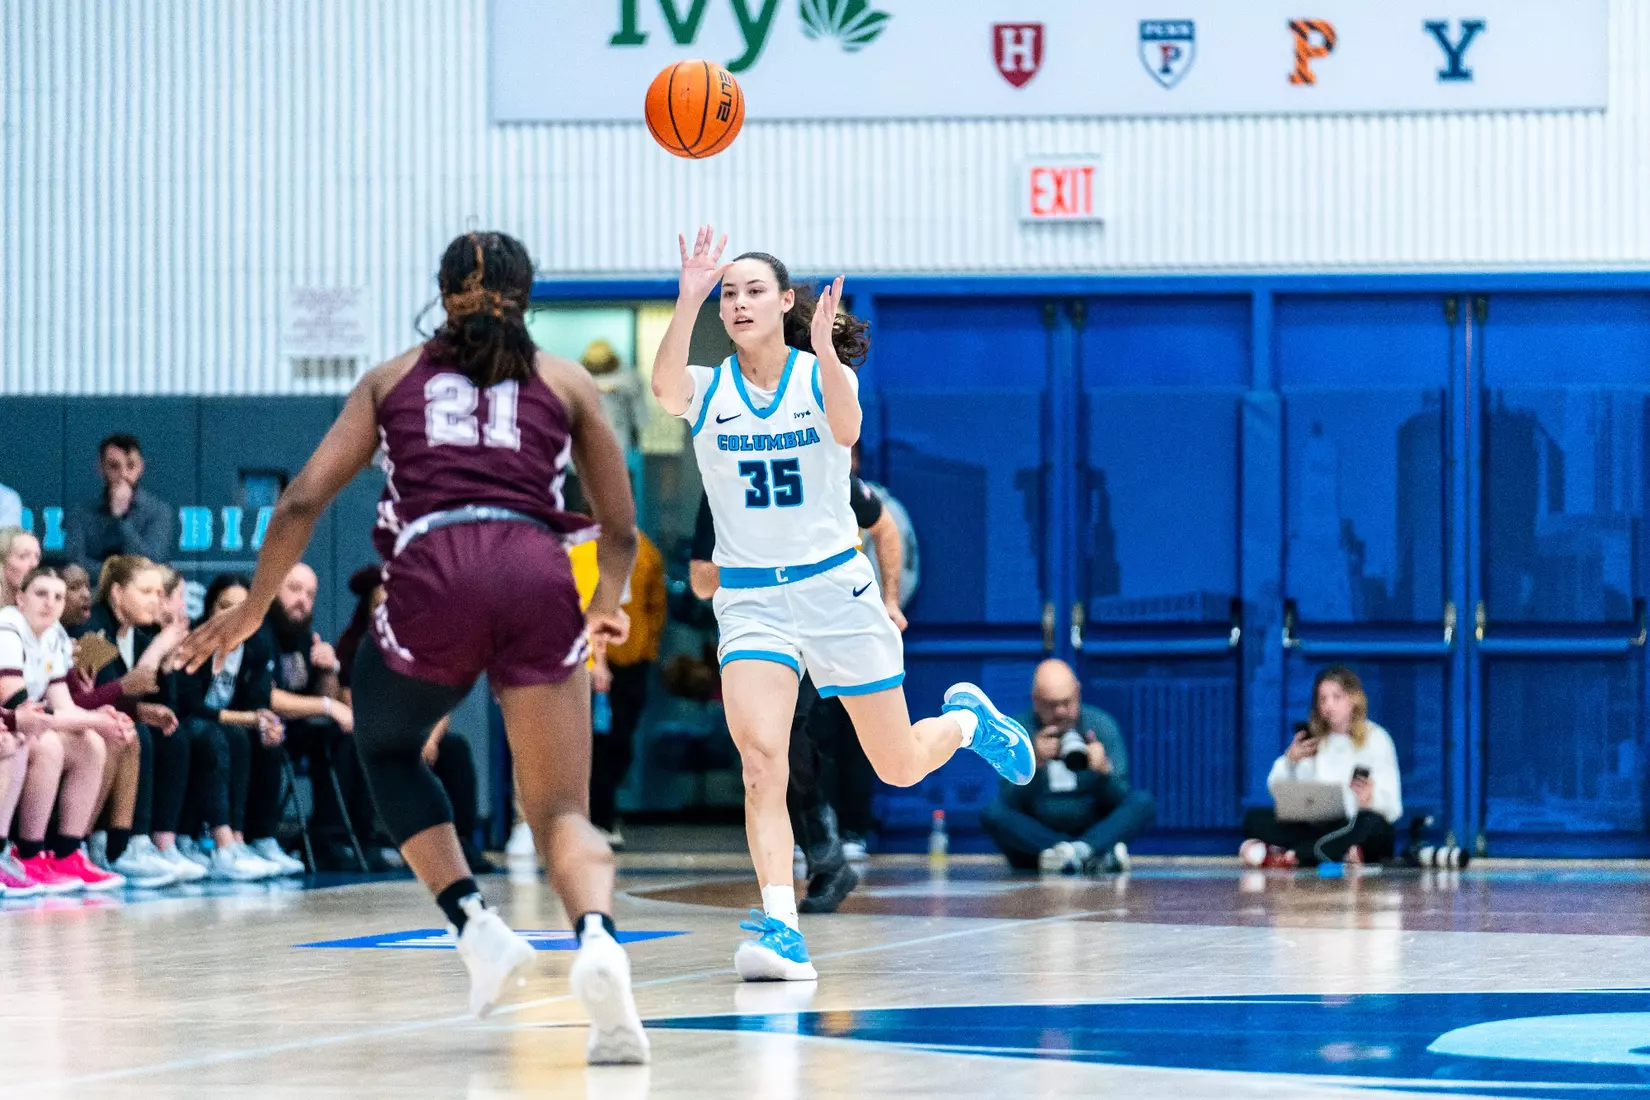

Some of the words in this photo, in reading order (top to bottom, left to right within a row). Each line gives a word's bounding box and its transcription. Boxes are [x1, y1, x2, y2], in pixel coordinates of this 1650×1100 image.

[1001, 27, 1035, 71] H
[1160, 44, 1181, 74] P
[1288, 18, 1337, 85] P
[1423, 19, 1486, 82] Y
[716, 71, 732, 122] ELITE
[1030, 165, 1095, 216] EXIT
[424, 372, 521, 451] 21
[717, 427, 820, 452] COLUMBIA
[738, 457, 804, 509] 35
